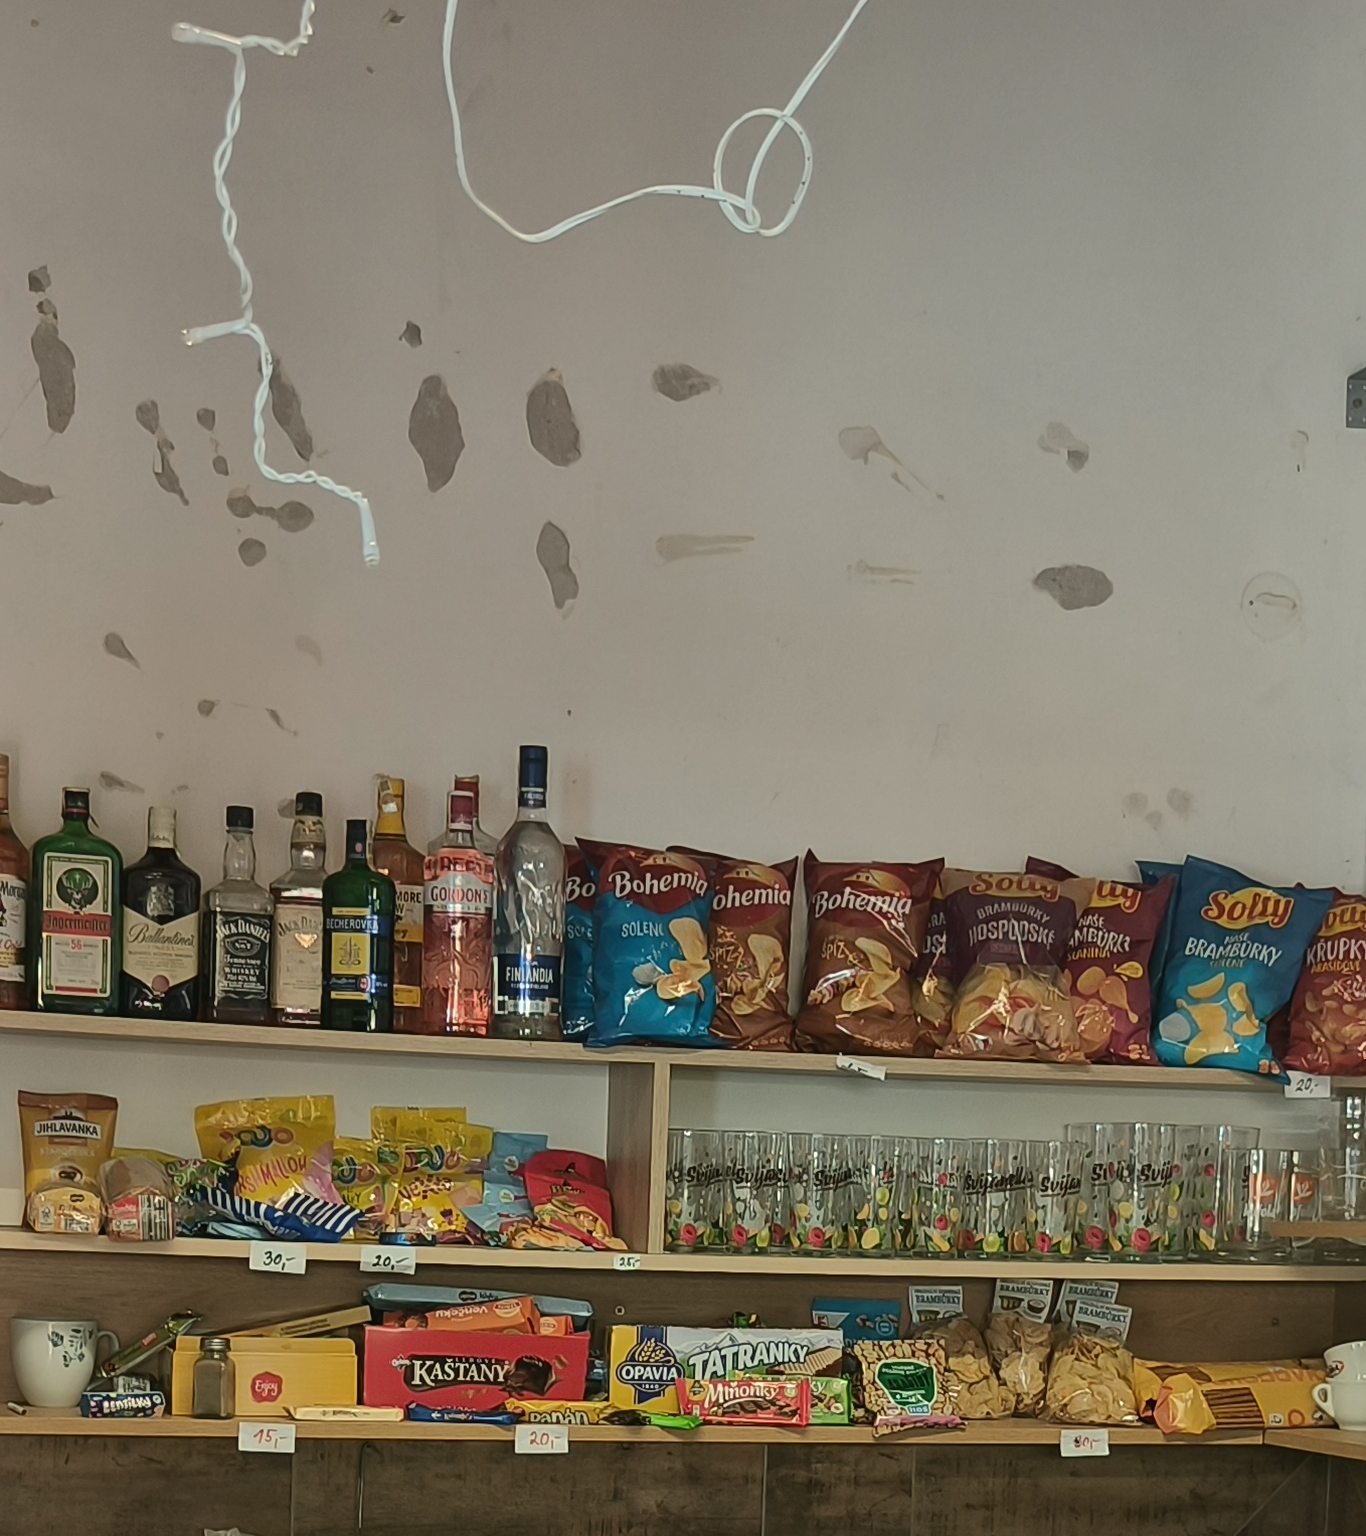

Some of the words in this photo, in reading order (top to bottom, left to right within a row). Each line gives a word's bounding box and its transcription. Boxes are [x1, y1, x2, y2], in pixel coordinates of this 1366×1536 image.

[609, 871, 709, 899] Bohemia
[969, 873, 1061, 902] Solty
[713, 884, 791, 910] ohemia
[813, 889, 912, 918] Bohemia
[976, 901, 1051, 924] BRAMBŮRKY
[1201, 889, 1295, 928] Solty
[216, 921, 238, 938] JACK
[326, 917, 379, 931] BECHEROVKA
[70, 939, 82, 951] 56
[127, 923, 196, 949] Ballantine's
[1067, 928, 1131, 953] AMBŮRKY
[1185, 937, 1283, 967] BRAMBŮRKY
[505, 966, 554, 983] FINLANDIA
[36, 1122, 99, 1137] JIHLAVANKA
[262, 1250, 297, 1271] 30,-
[372, 1254, 411, 1270] 20,-
[1000, 1282, 1051, 1297] BRAMBŮRKY
[1067, 1286, 1117, 1299] BRAMBŮRKY
[1077, 1305, 1128, 1323] BRAMBŮRKY
[689, 1341, 810, 1381] TATRANKY
[411, 1357, 509, 1387] KAŠTANY
[621, 1366, 679, 1382] OPAVIA
[254, 1380, 278, 1397] Enjoy
[253, 1428, 288, 1449] 15,-
[529, 1431, 562, 1450] 20,-
